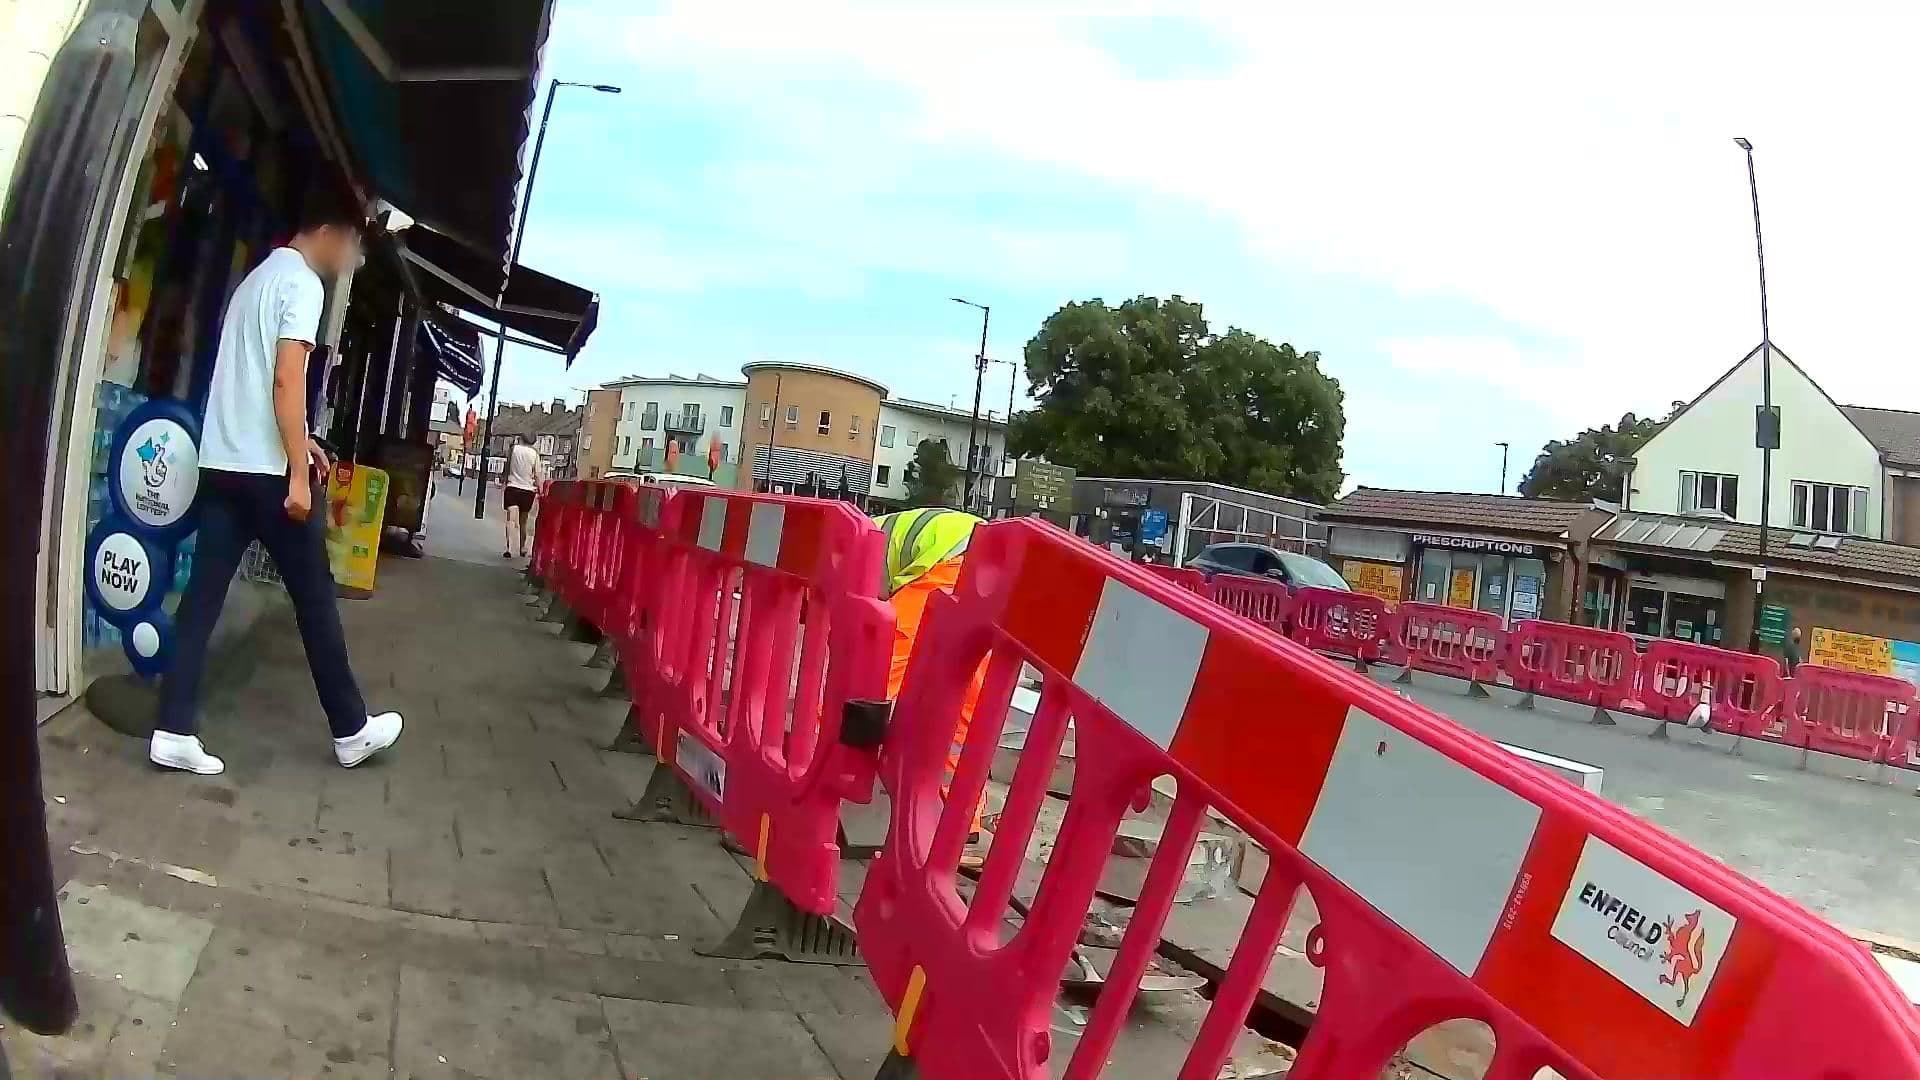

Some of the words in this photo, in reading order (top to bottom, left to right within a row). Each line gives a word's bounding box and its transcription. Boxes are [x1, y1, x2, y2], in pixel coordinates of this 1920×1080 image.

[1413, 534, 1533, 555] PRESCRIPTIONS
[104, 551, 141, 576] PLAY
[101, 567, 138, 593] NOW
[1579, 881, 1663, 945] ENFIELD
